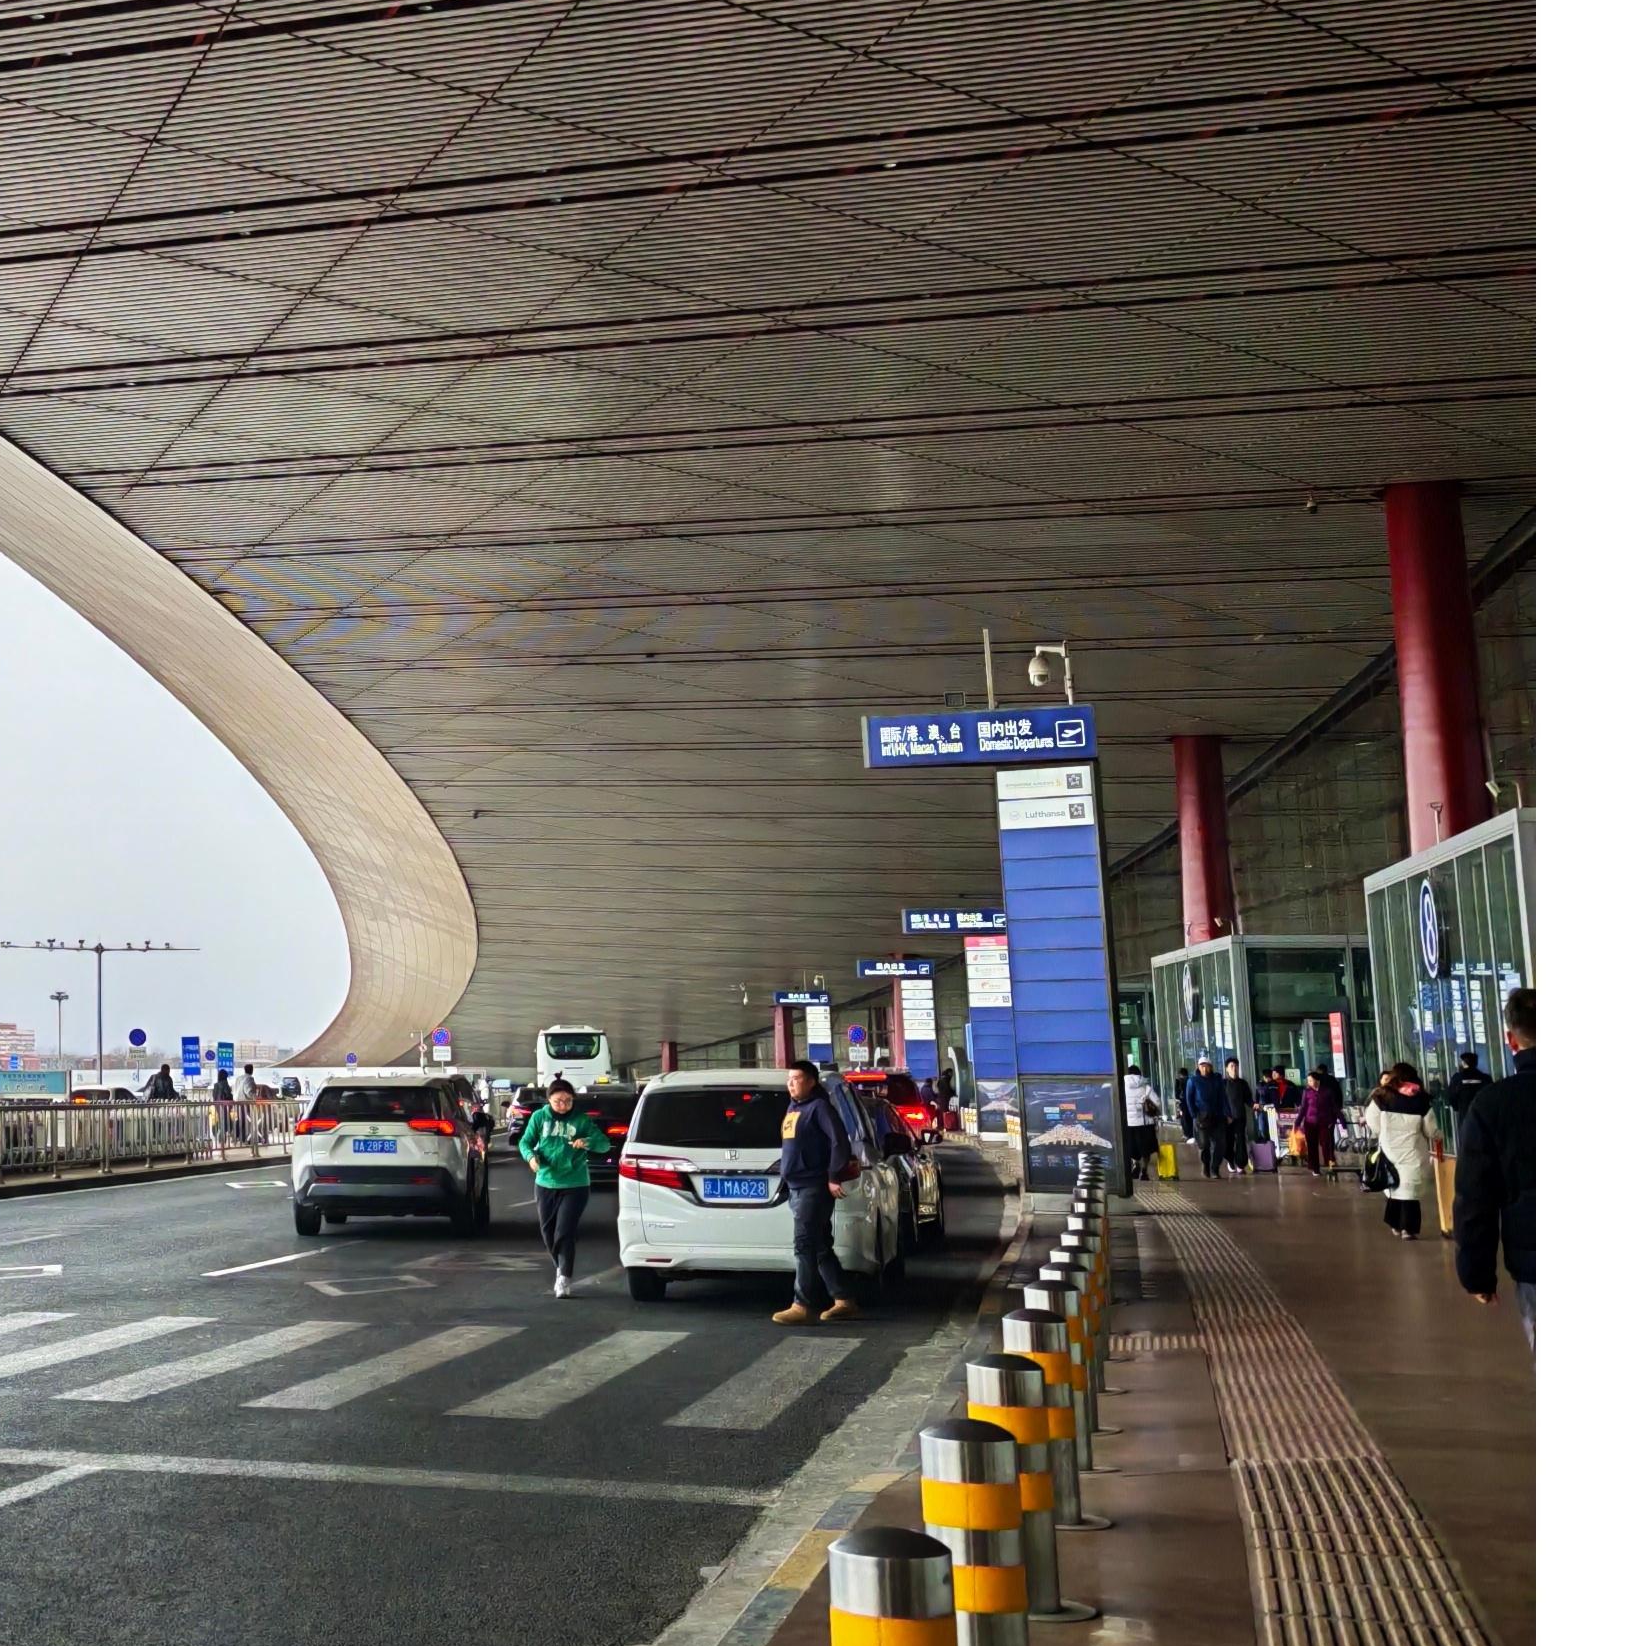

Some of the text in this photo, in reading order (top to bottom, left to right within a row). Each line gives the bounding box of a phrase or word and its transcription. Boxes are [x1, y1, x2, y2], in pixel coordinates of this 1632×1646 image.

[977, 718, 1032, 738] 国内出发
[979, 736, 1054, 752] Domestic Departures
[1025, 810, 1066, 819] Lufthansa
[1424, 893, 1436, 964] 8
